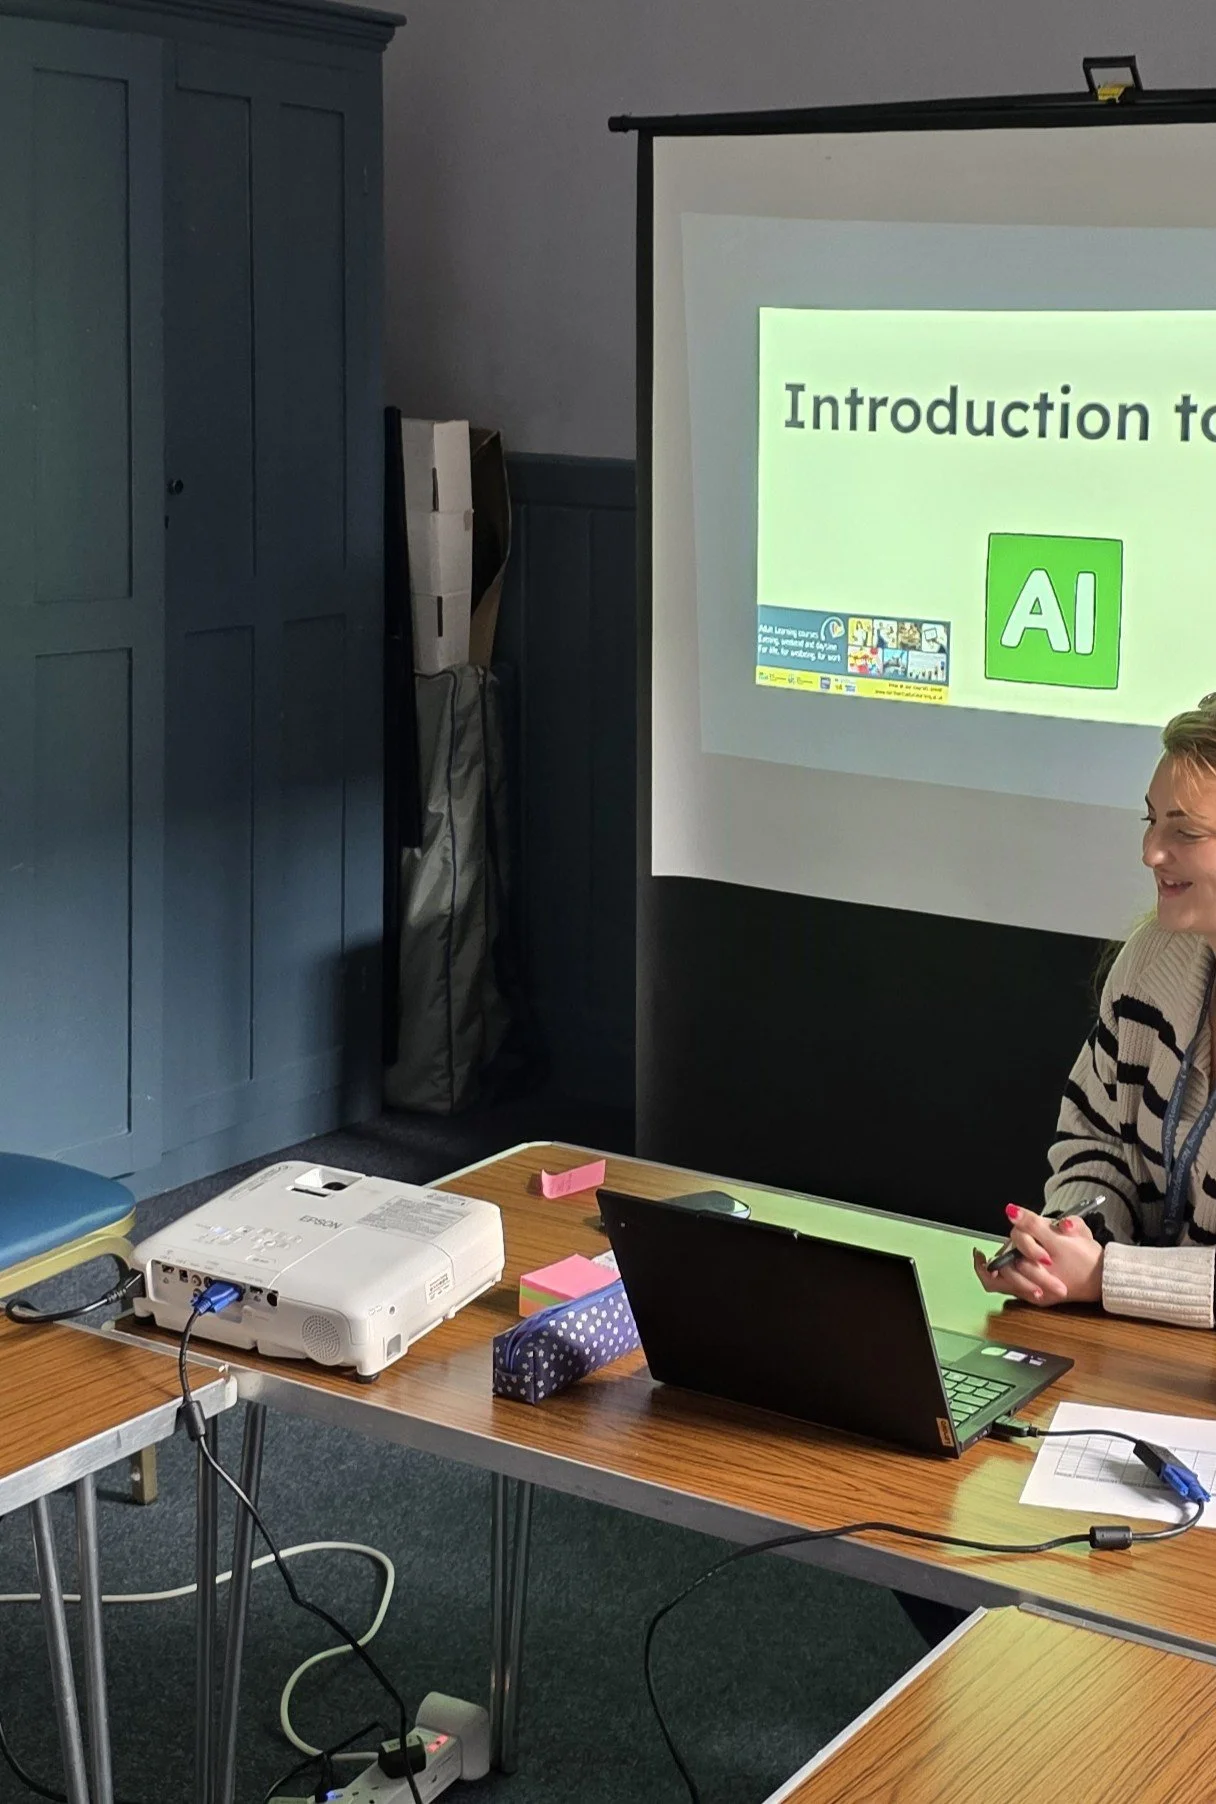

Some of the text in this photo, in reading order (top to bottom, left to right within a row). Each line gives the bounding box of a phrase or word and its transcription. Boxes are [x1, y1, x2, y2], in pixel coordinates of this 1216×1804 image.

[784, 382, 1151, 442] Introduction
[1000, 567, 1097, 656] AI
[774, 626, 798, 639] Learning
[798, 629, 819, 639] courses
[804, 640, 815, 649] and
[299, 1214, 343, 1229] EPSON
